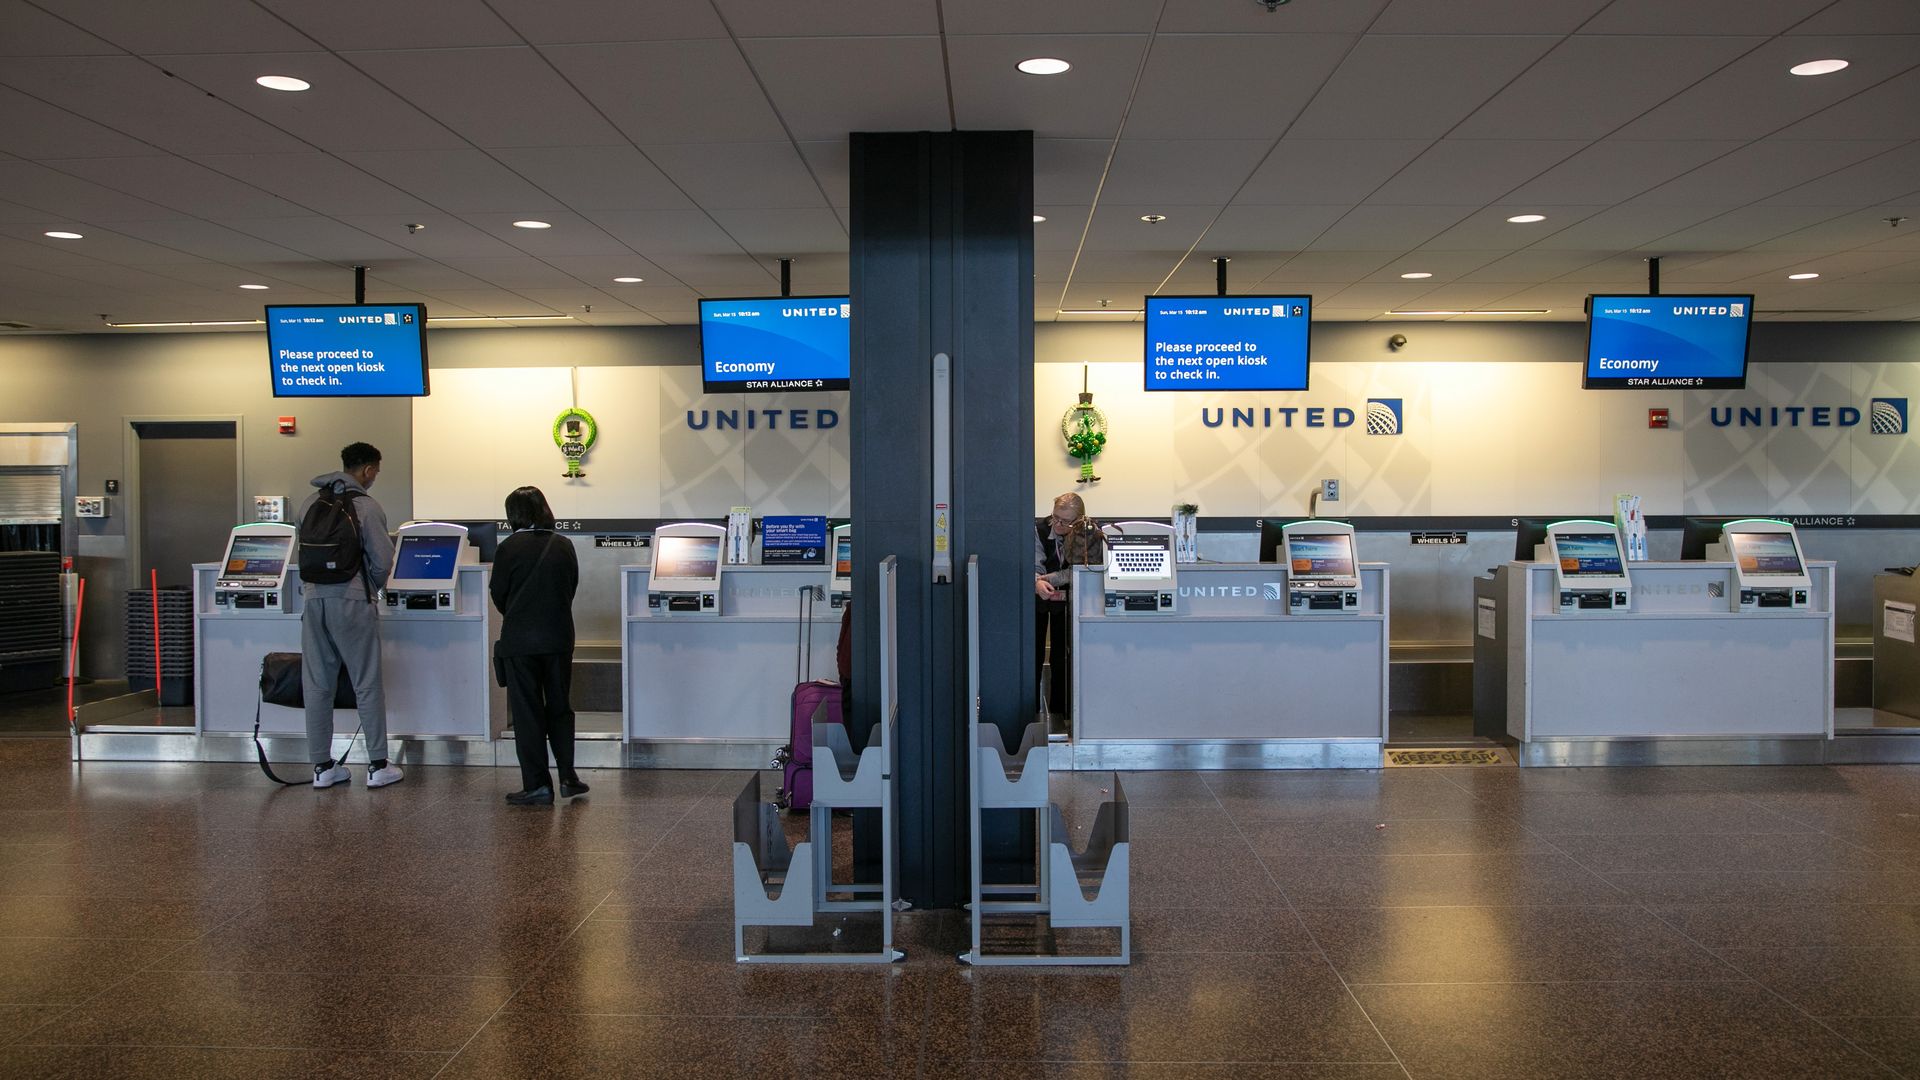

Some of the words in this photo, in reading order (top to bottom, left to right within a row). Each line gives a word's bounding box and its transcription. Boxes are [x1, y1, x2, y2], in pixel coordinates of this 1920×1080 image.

[782, 308, 838, 317] UNITED
[1223, 308, 1270, 316] UNITED
[1673, 306, 1727, 315] UNITED
[339, 316, 383, 324] UNITED
[1155, 342, 1192, 352] Please
[1195, 342, 1241, 354] proceed
[1244, 343, 1257, 352] to
[279, 350, 314, 359] Please
[316, 349, 359, 361] proceed
[362, 350, 373, 359] to
[1155, 356, 1174, 366] the
[1177, 357, 1202, 365] next
[1205, 357, 1234, 367] open
[1237, 355, 1267, 365] kiosk
[1600, 358, 1659, 372] Economy
[280, 363, 298, 372] the
[301, 364, 324, 372] next
[327, 364, 354, 374] open
[357, 362, 385, 372] kiosk
[715, 361, 775, 374] Economy
[1155, 370, 1167, 379] to
[1170, 369, 1203, 379] check
[1206, 370, 1220, 379] in.
[282, 377, 293, 386] to
[296, 376, 326, 386] check
[329, 376, 342, 386] in.
[770, 380, 813, 388] ALLIANCE
[687, 409, 839, 430] UNITED
[1202, 407, 1356, 428] UNITED
[1711, 406, 1861, 427] UNITED
[1793, 517, 1843, 525] ALLIANCE
[1179, 586, 1257, 597] UNITED
[1397, 753, 1436, 761] KEEP
[1441, 753, 1491, 761] CLEAR
